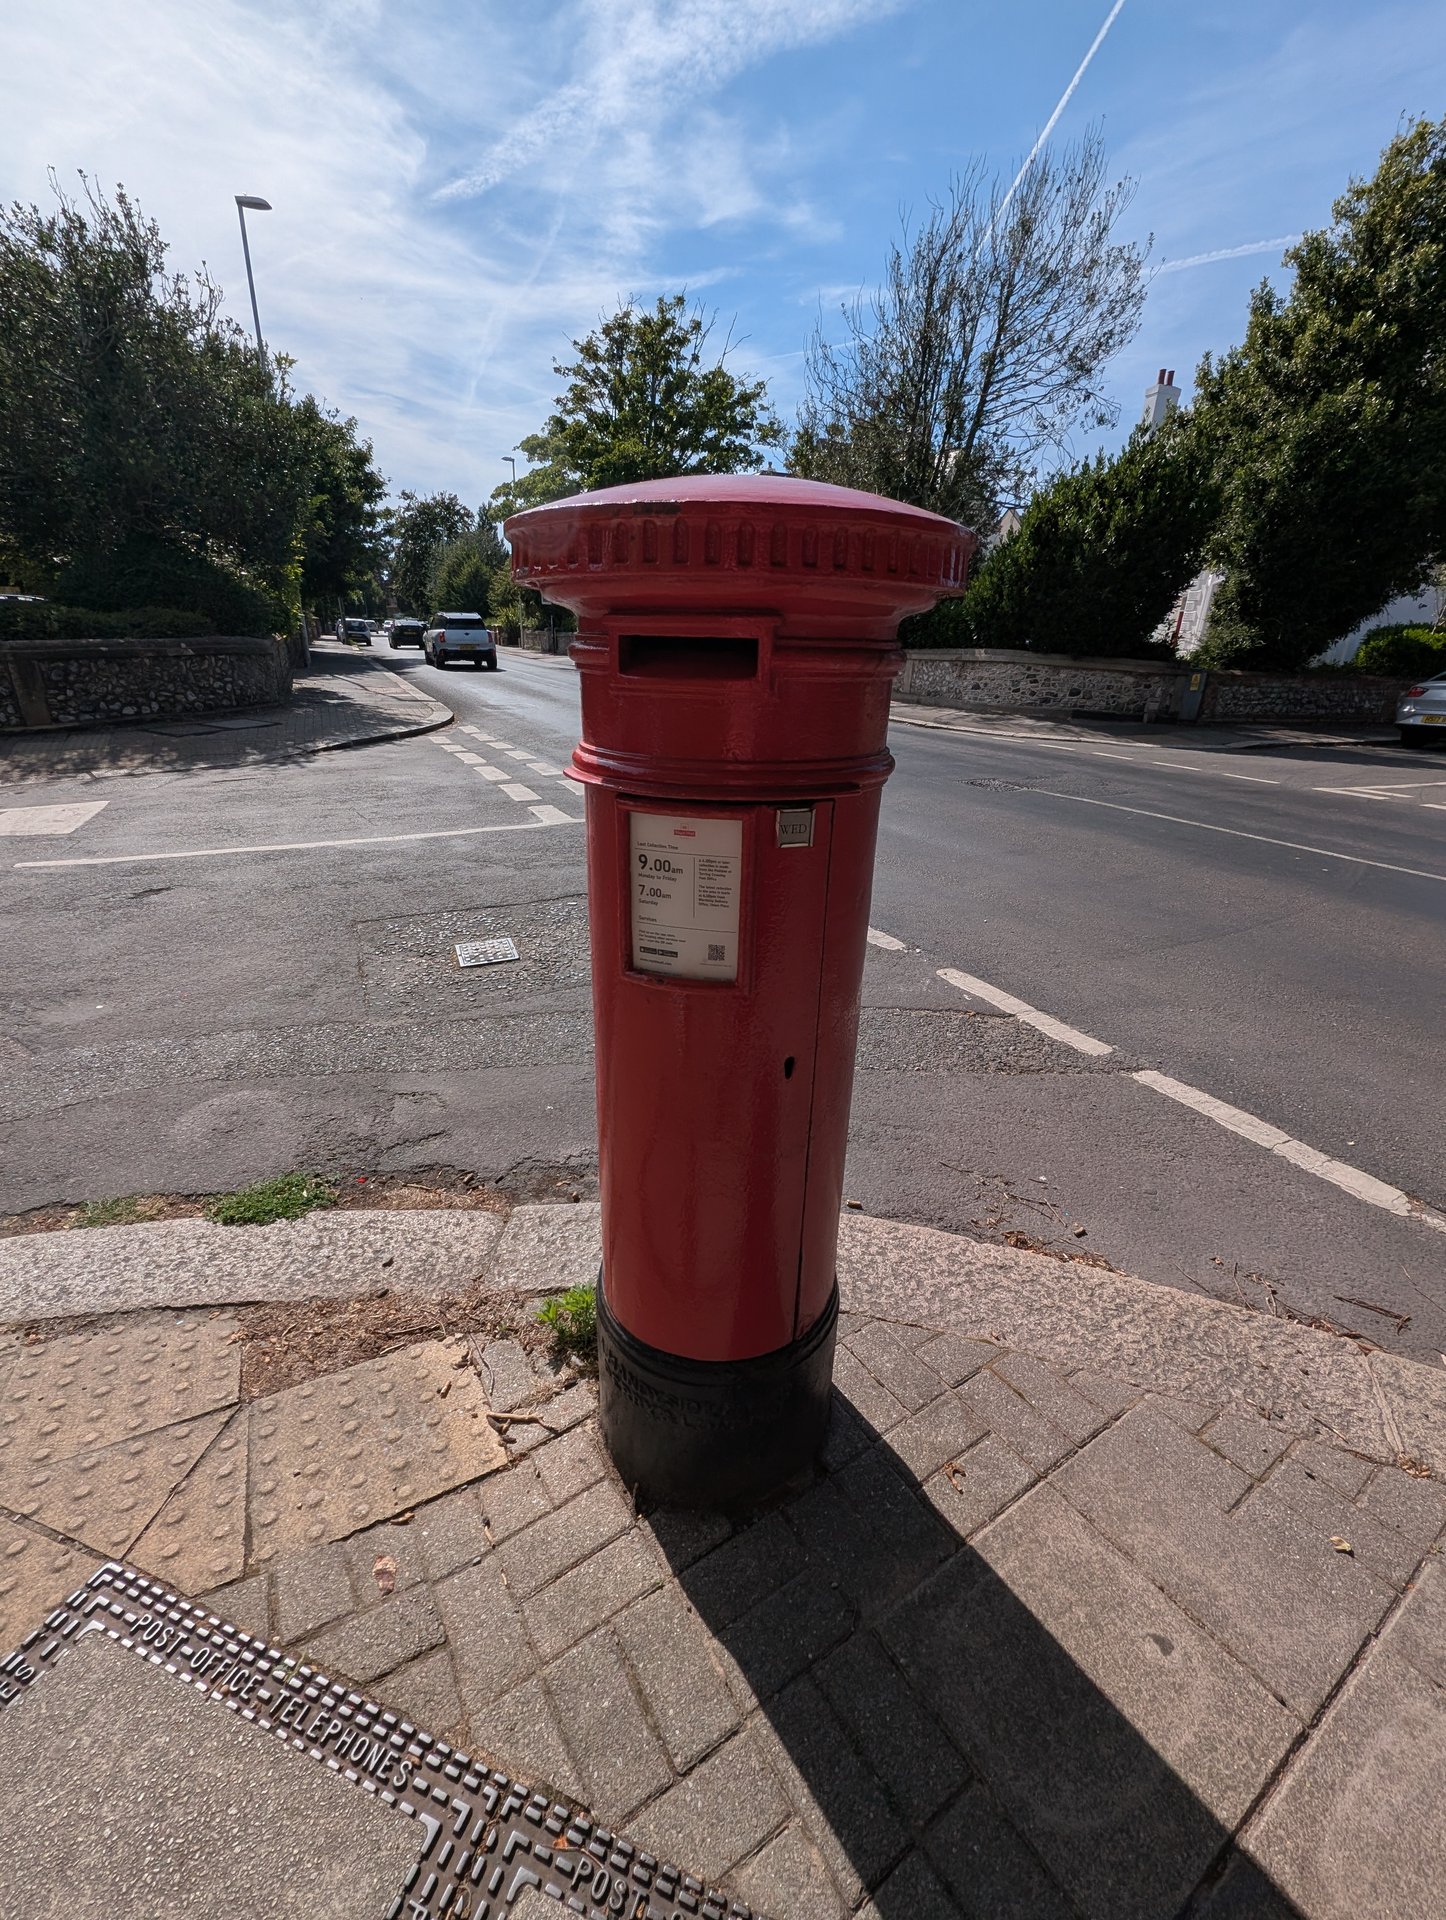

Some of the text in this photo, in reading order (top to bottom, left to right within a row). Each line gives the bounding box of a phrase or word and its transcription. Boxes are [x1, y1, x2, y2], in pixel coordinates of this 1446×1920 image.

[779, 824, 807, 835] WED
[638, 854, 683, 874] 9.00am
[638, 884, 672, 899] 7.00am
[130, 1613, 413, 1788] POST OFFICE TELEPHONES
[571, 1857, 649, 1919] POST
